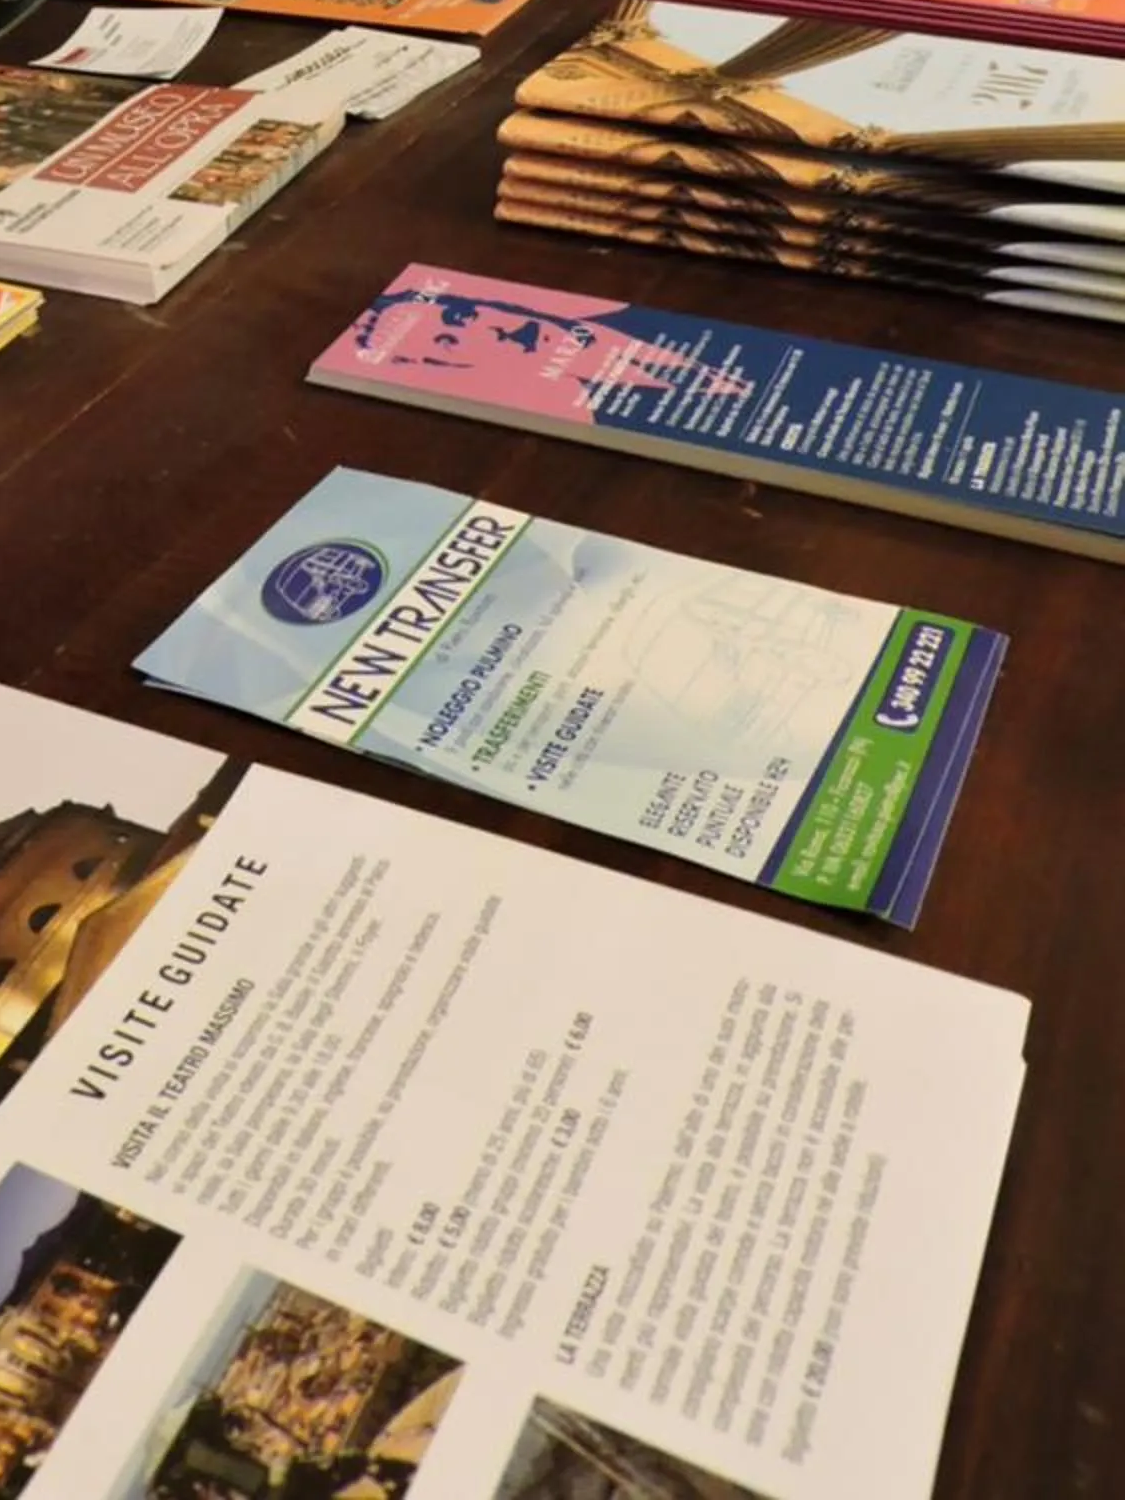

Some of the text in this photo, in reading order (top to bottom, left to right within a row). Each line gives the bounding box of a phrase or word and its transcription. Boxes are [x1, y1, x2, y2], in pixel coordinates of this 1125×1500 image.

[309, 642, 409, 726] NEW
[374, 514, 516, 644] TRANSFER
[420, 678, 482, 748] NOLEGGIO
[469, 622, 524, 679] PULMINO
[470, 670, 553, 765] TRASFERIMENTI
[526, 741, 570, 782] VISITE
[554, 685, 605, 741] GUIDATE
[638, 770, 687, 830] ELEGANTE
[666, 768, 720, 839] RISERVATO
[694, 782, 745, 849] PUNTUALE
[725, 779, 781, 860] DISPONIBILE
[69, 852, 270, 1104] VISITE GUIDATE
[110, 977, 256, 1170] VISITA IL TEATRO MASSIMO
[555, 1263, 610, 1366] LA TERRAZZA
